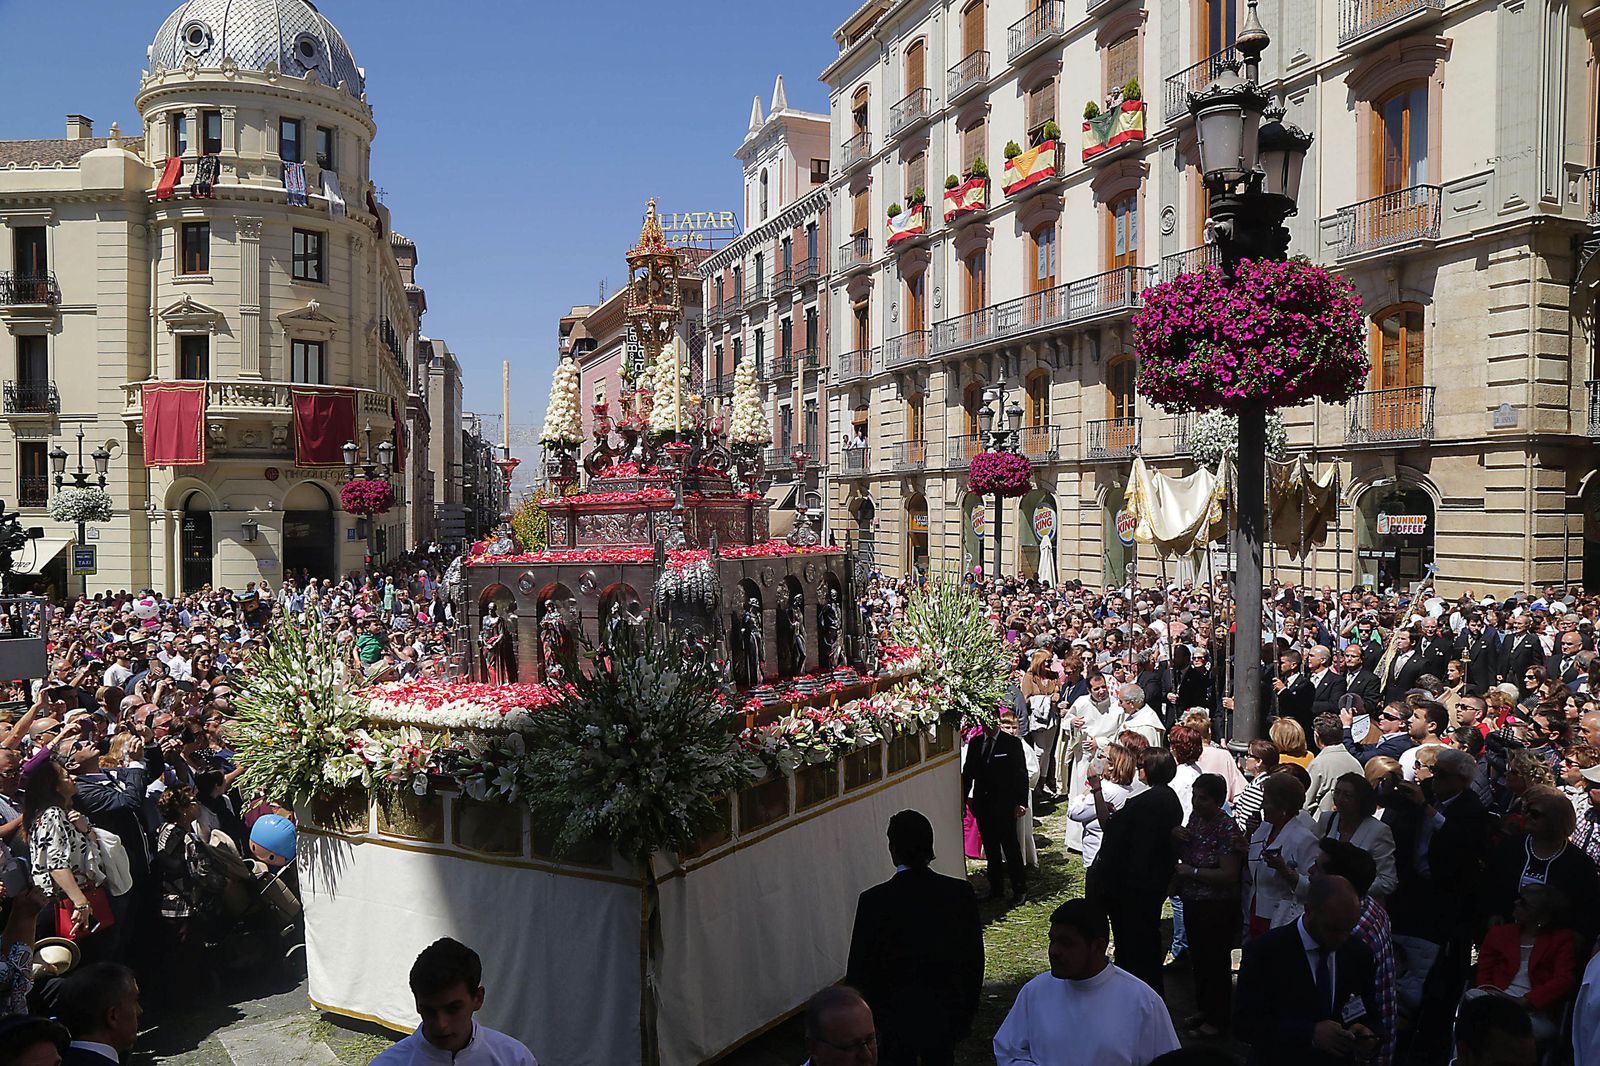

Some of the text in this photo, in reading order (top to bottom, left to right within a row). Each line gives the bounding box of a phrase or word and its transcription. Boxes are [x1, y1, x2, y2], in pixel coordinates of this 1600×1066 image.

[1035, 511, 1052, 522] BURGER
[1391, 516, 1426, 524] DUNKIN'
[1035, 518, 1053, 532] KING
[1391, 525, 1423, 533] COFFEE
